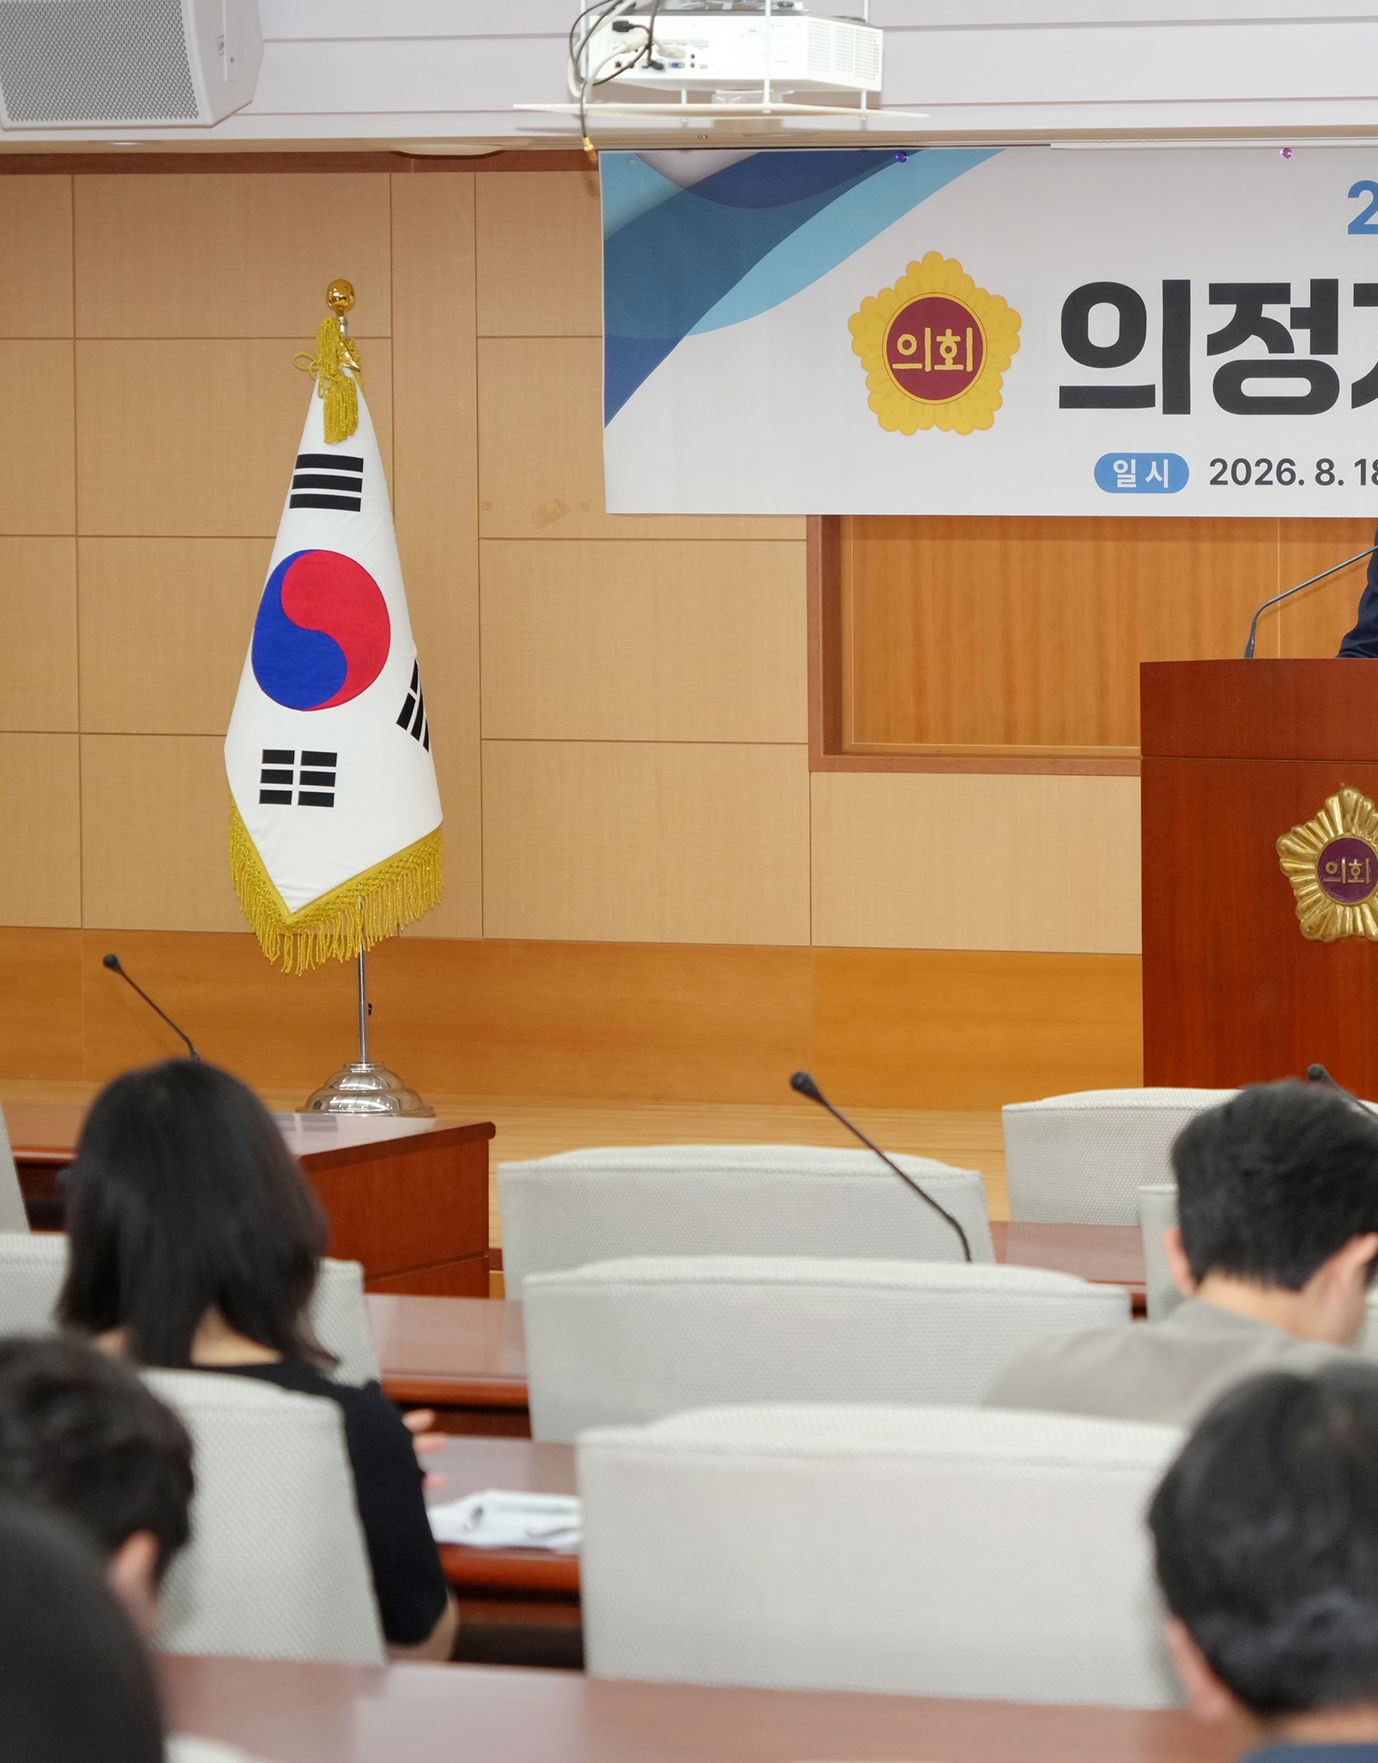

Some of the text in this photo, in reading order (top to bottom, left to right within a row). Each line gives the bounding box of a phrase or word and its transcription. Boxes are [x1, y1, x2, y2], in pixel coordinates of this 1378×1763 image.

[892, 327, 973, 372] 의회
[1209, 457, 1304, 487] 2026.
[1314, 457, 1344, 487] 8.
[1323, 858, 1370, 884] 의회
